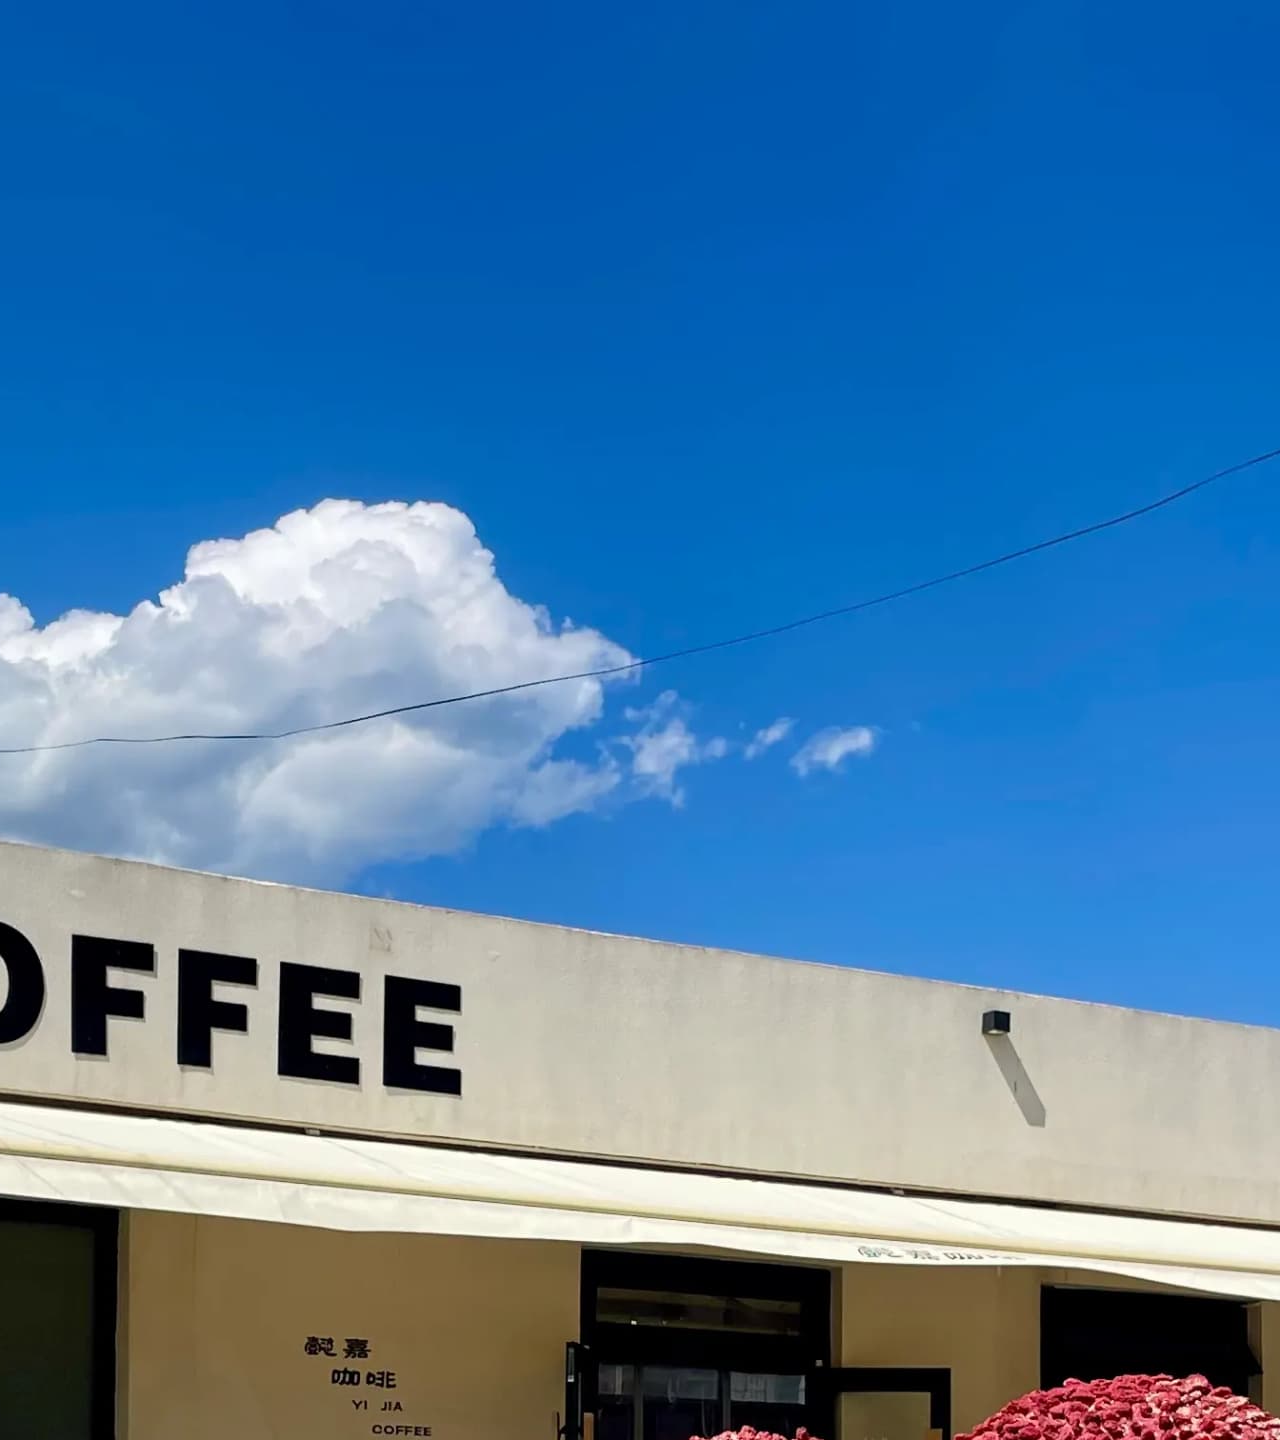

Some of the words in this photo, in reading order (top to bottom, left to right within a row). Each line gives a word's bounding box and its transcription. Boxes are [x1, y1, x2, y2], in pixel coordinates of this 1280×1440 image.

[331, 1367, 397, 1389] 咖啡
[352, 1400, 368, 1411] YI
[381, 1401, 403, 1412] JIA
[372, 1424, 433, 1437] COFFEE
